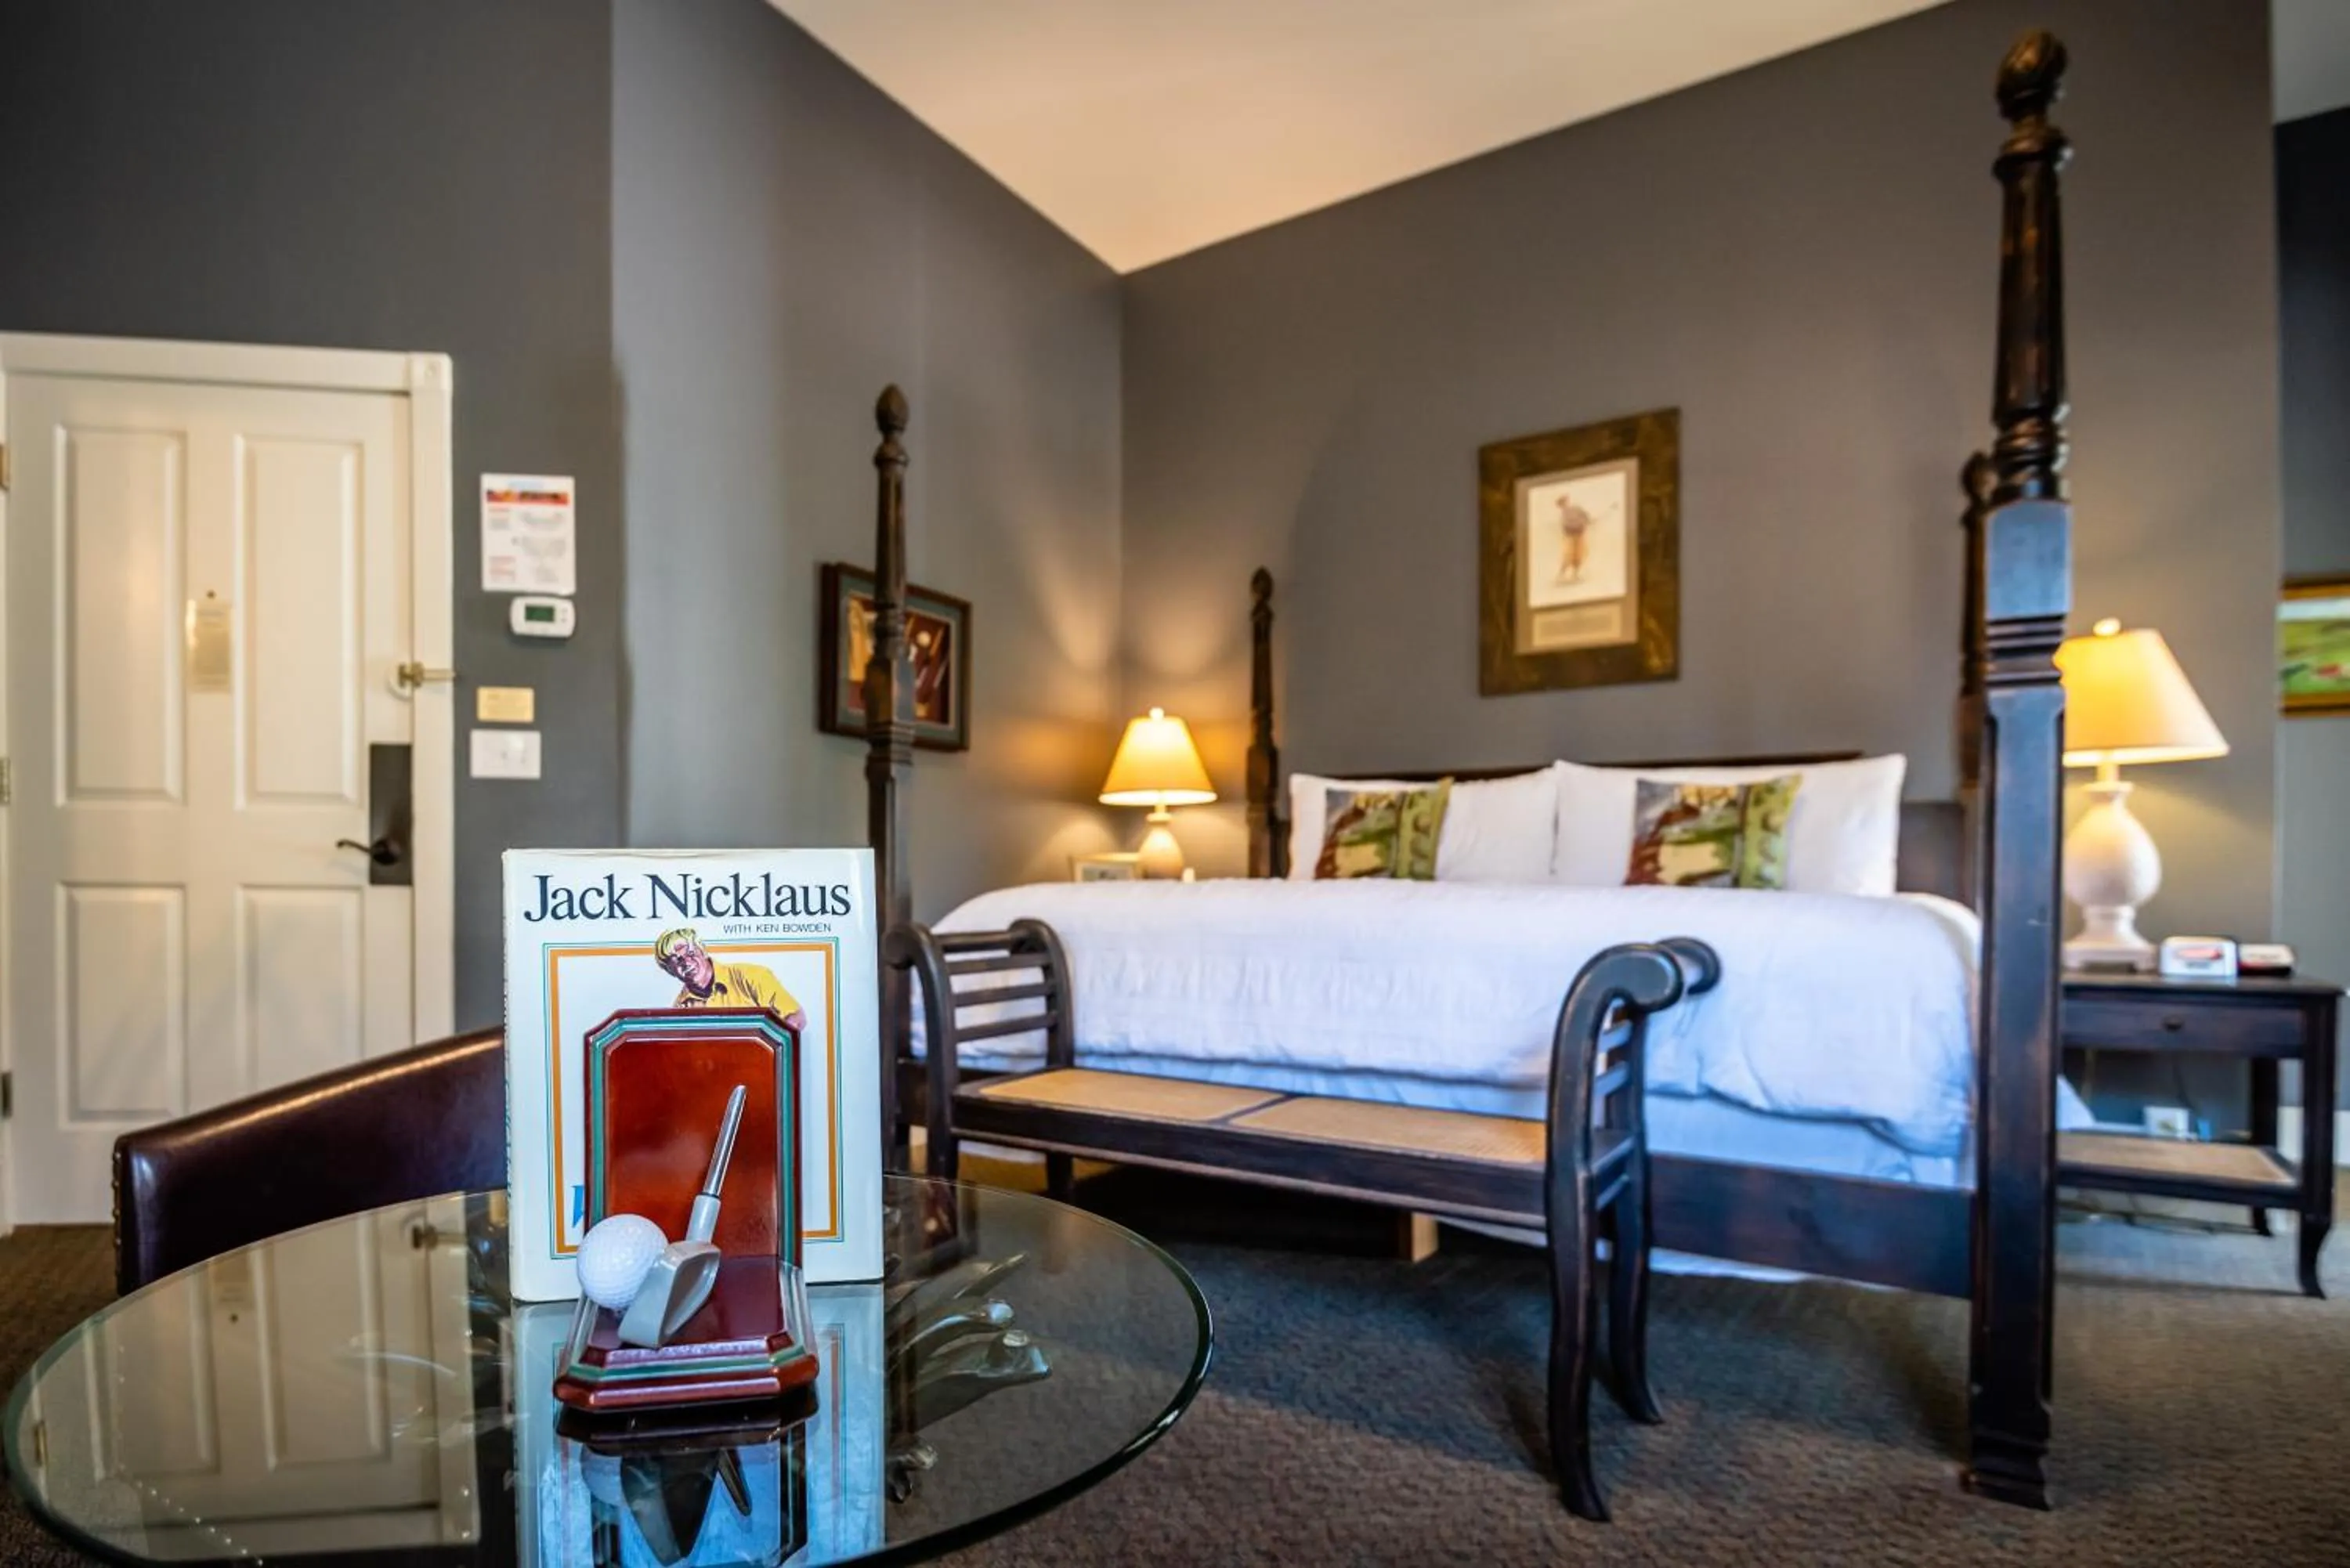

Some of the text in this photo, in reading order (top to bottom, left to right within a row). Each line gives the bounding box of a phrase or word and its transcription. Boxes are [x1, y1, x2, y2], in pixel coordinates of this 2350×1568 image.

[524, 872, 851, 922] Jack Nicklaus
[723, 922, 831, 934] WITH KEN BOWDEN
